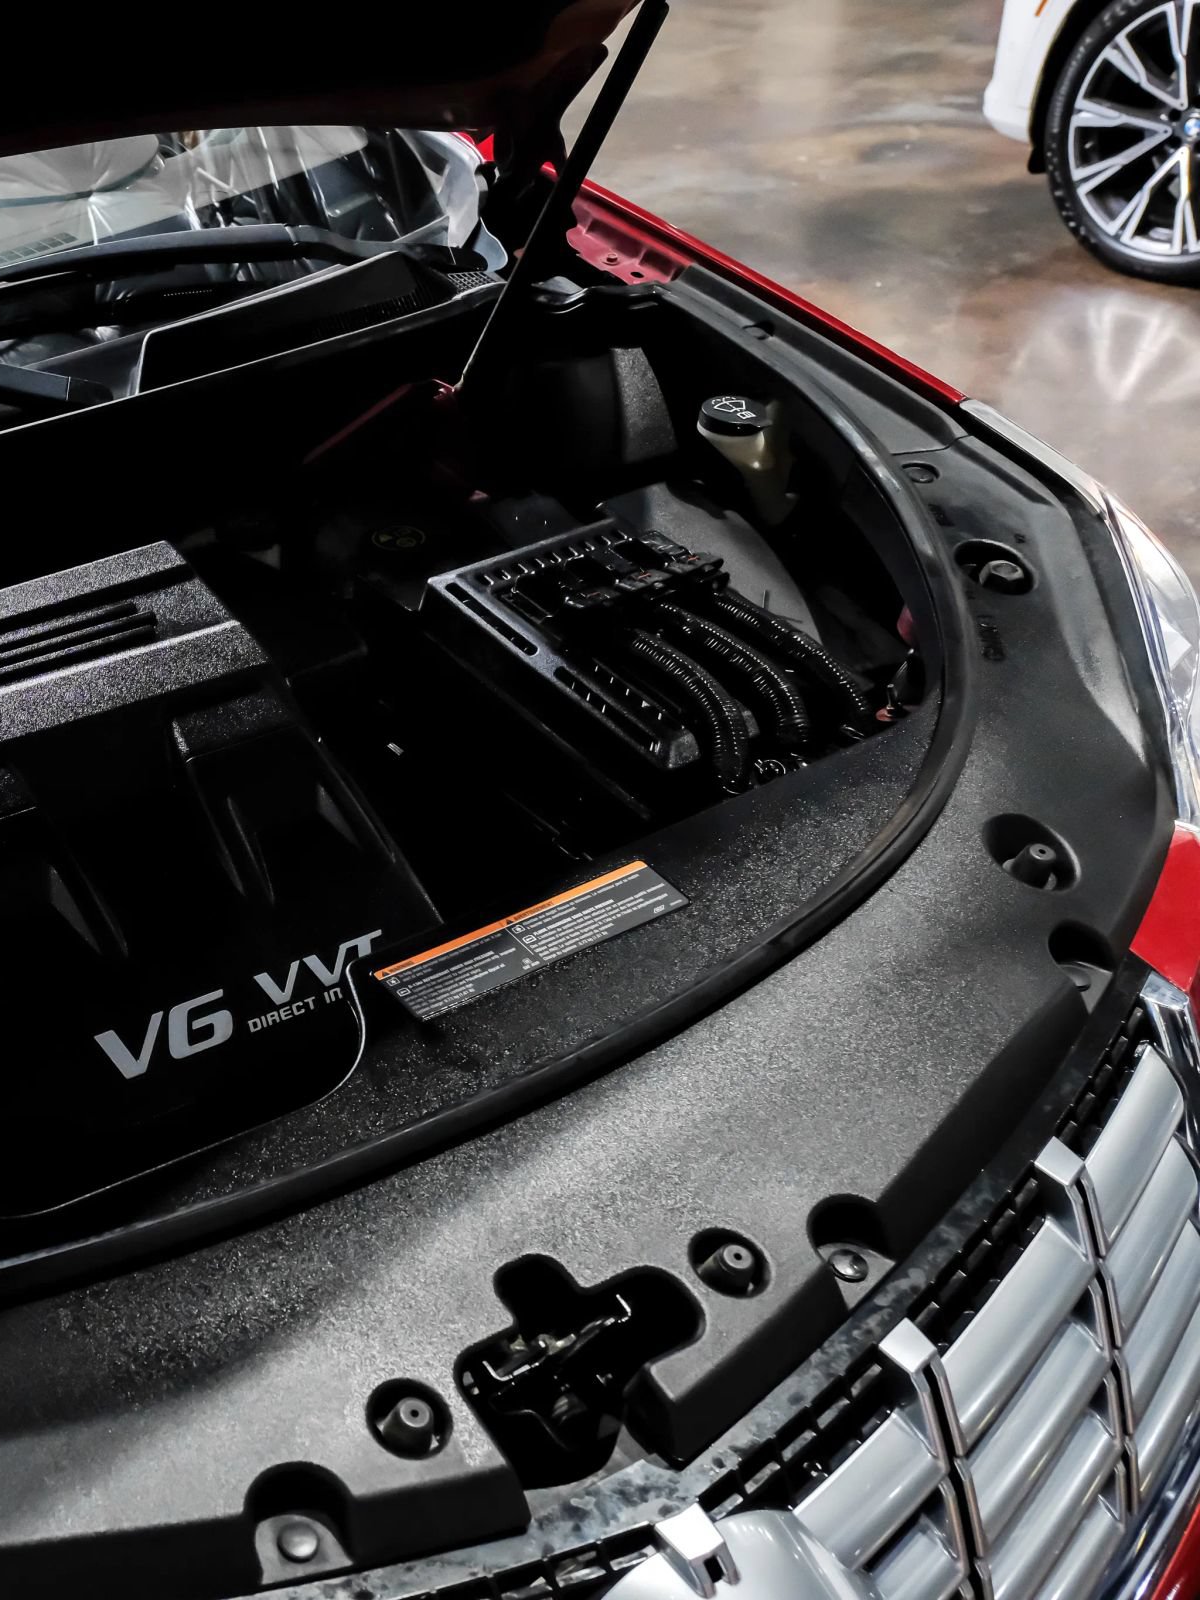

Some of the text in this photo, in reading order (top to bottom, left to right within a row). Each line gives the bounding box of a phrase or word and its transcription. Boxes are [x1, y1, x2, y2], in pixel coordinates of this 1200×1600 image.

[93, 988, 233, 1079] V6
[253, 929, 382, 1006] VVT
[247, 996, 316, 1033] DIRECT
